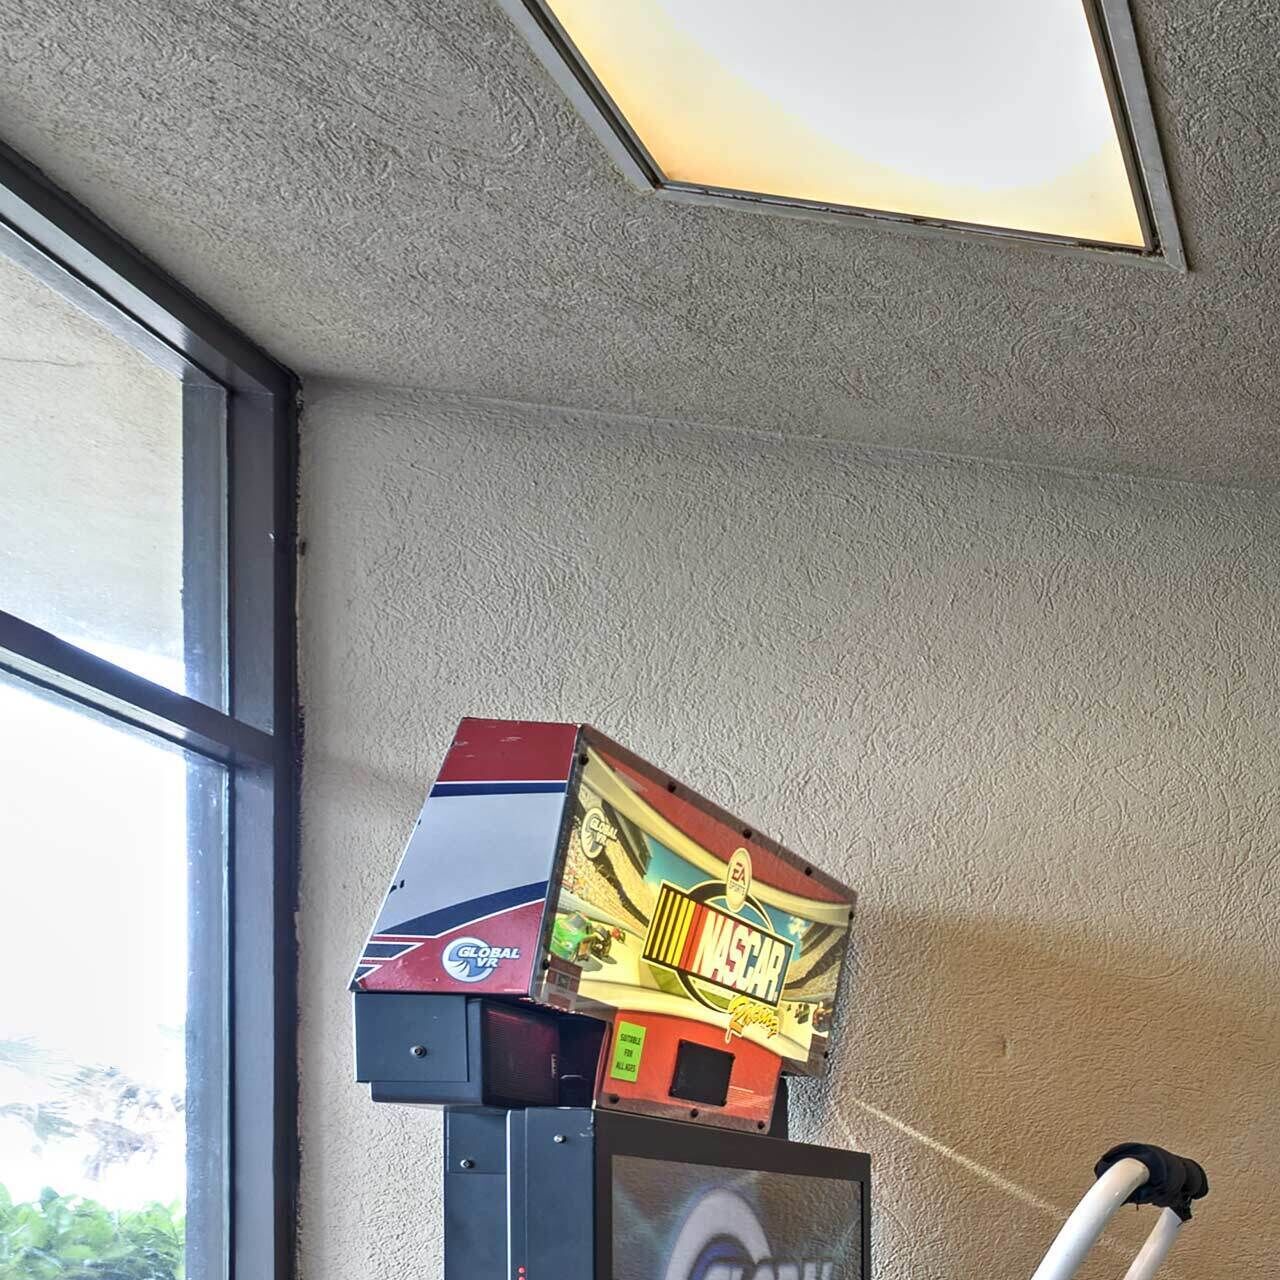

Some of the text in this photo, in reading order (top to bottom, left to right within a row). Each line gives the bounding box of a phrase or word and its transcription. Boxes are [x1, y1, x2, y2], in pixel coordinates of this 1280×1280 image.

[732, 862, 746, 885] EA
[458, 946, 520, 960] GLOBAL
[692, 910, 787, 1003] NASCAR
[477, 957, 498, 968] VR
